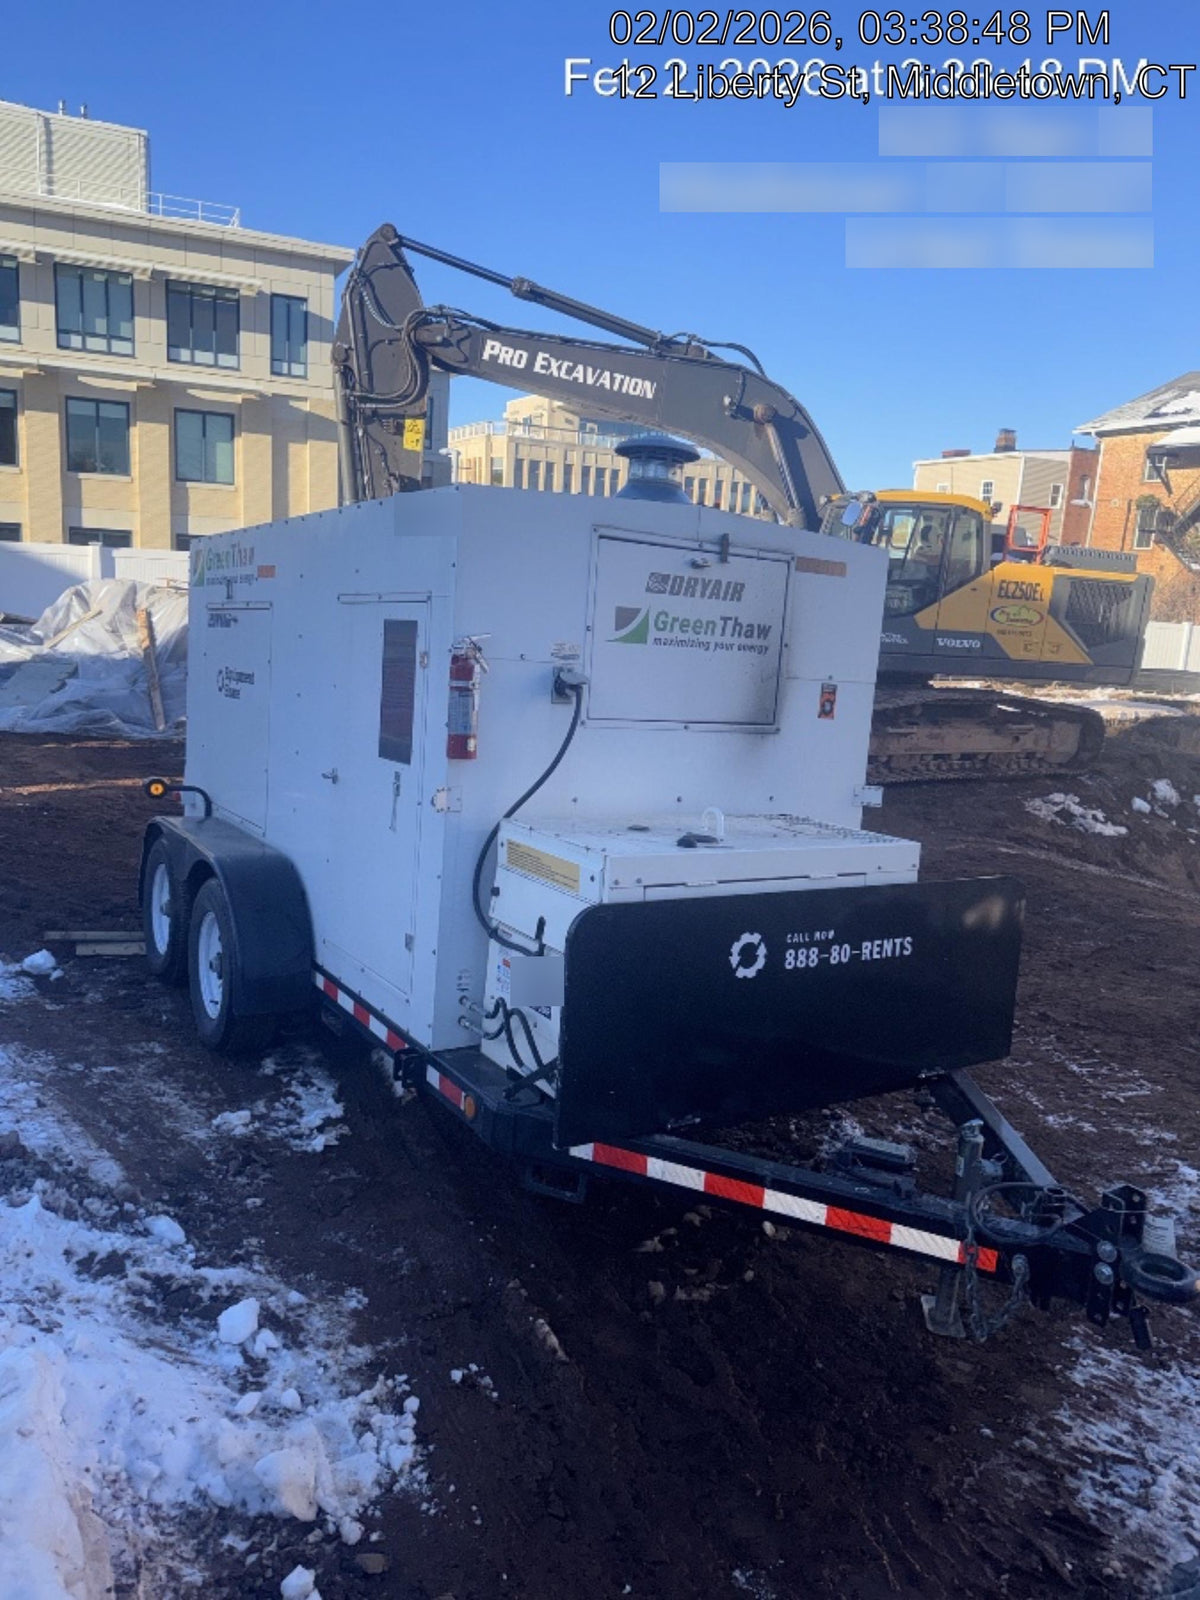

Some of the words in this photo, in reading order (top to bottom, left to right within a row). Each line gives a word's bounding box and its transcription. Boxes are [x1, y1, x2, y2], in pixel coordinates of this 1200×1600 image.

[482, 338, 529, 370] PRO
[532, 350, 657, 400] EXCAVATION
[668, 575, 746, 602] DRYAIR
[654, 610, 772, 641] GreenThaw
[653, 636, 712, 652] maximizing
[936, 637, 981, 649] VOLVO
[786, 932, 810, 943] CALL
[814, 929, 835, 941] NOW
[784, 936, 913, 970] 888-80-RENTS
